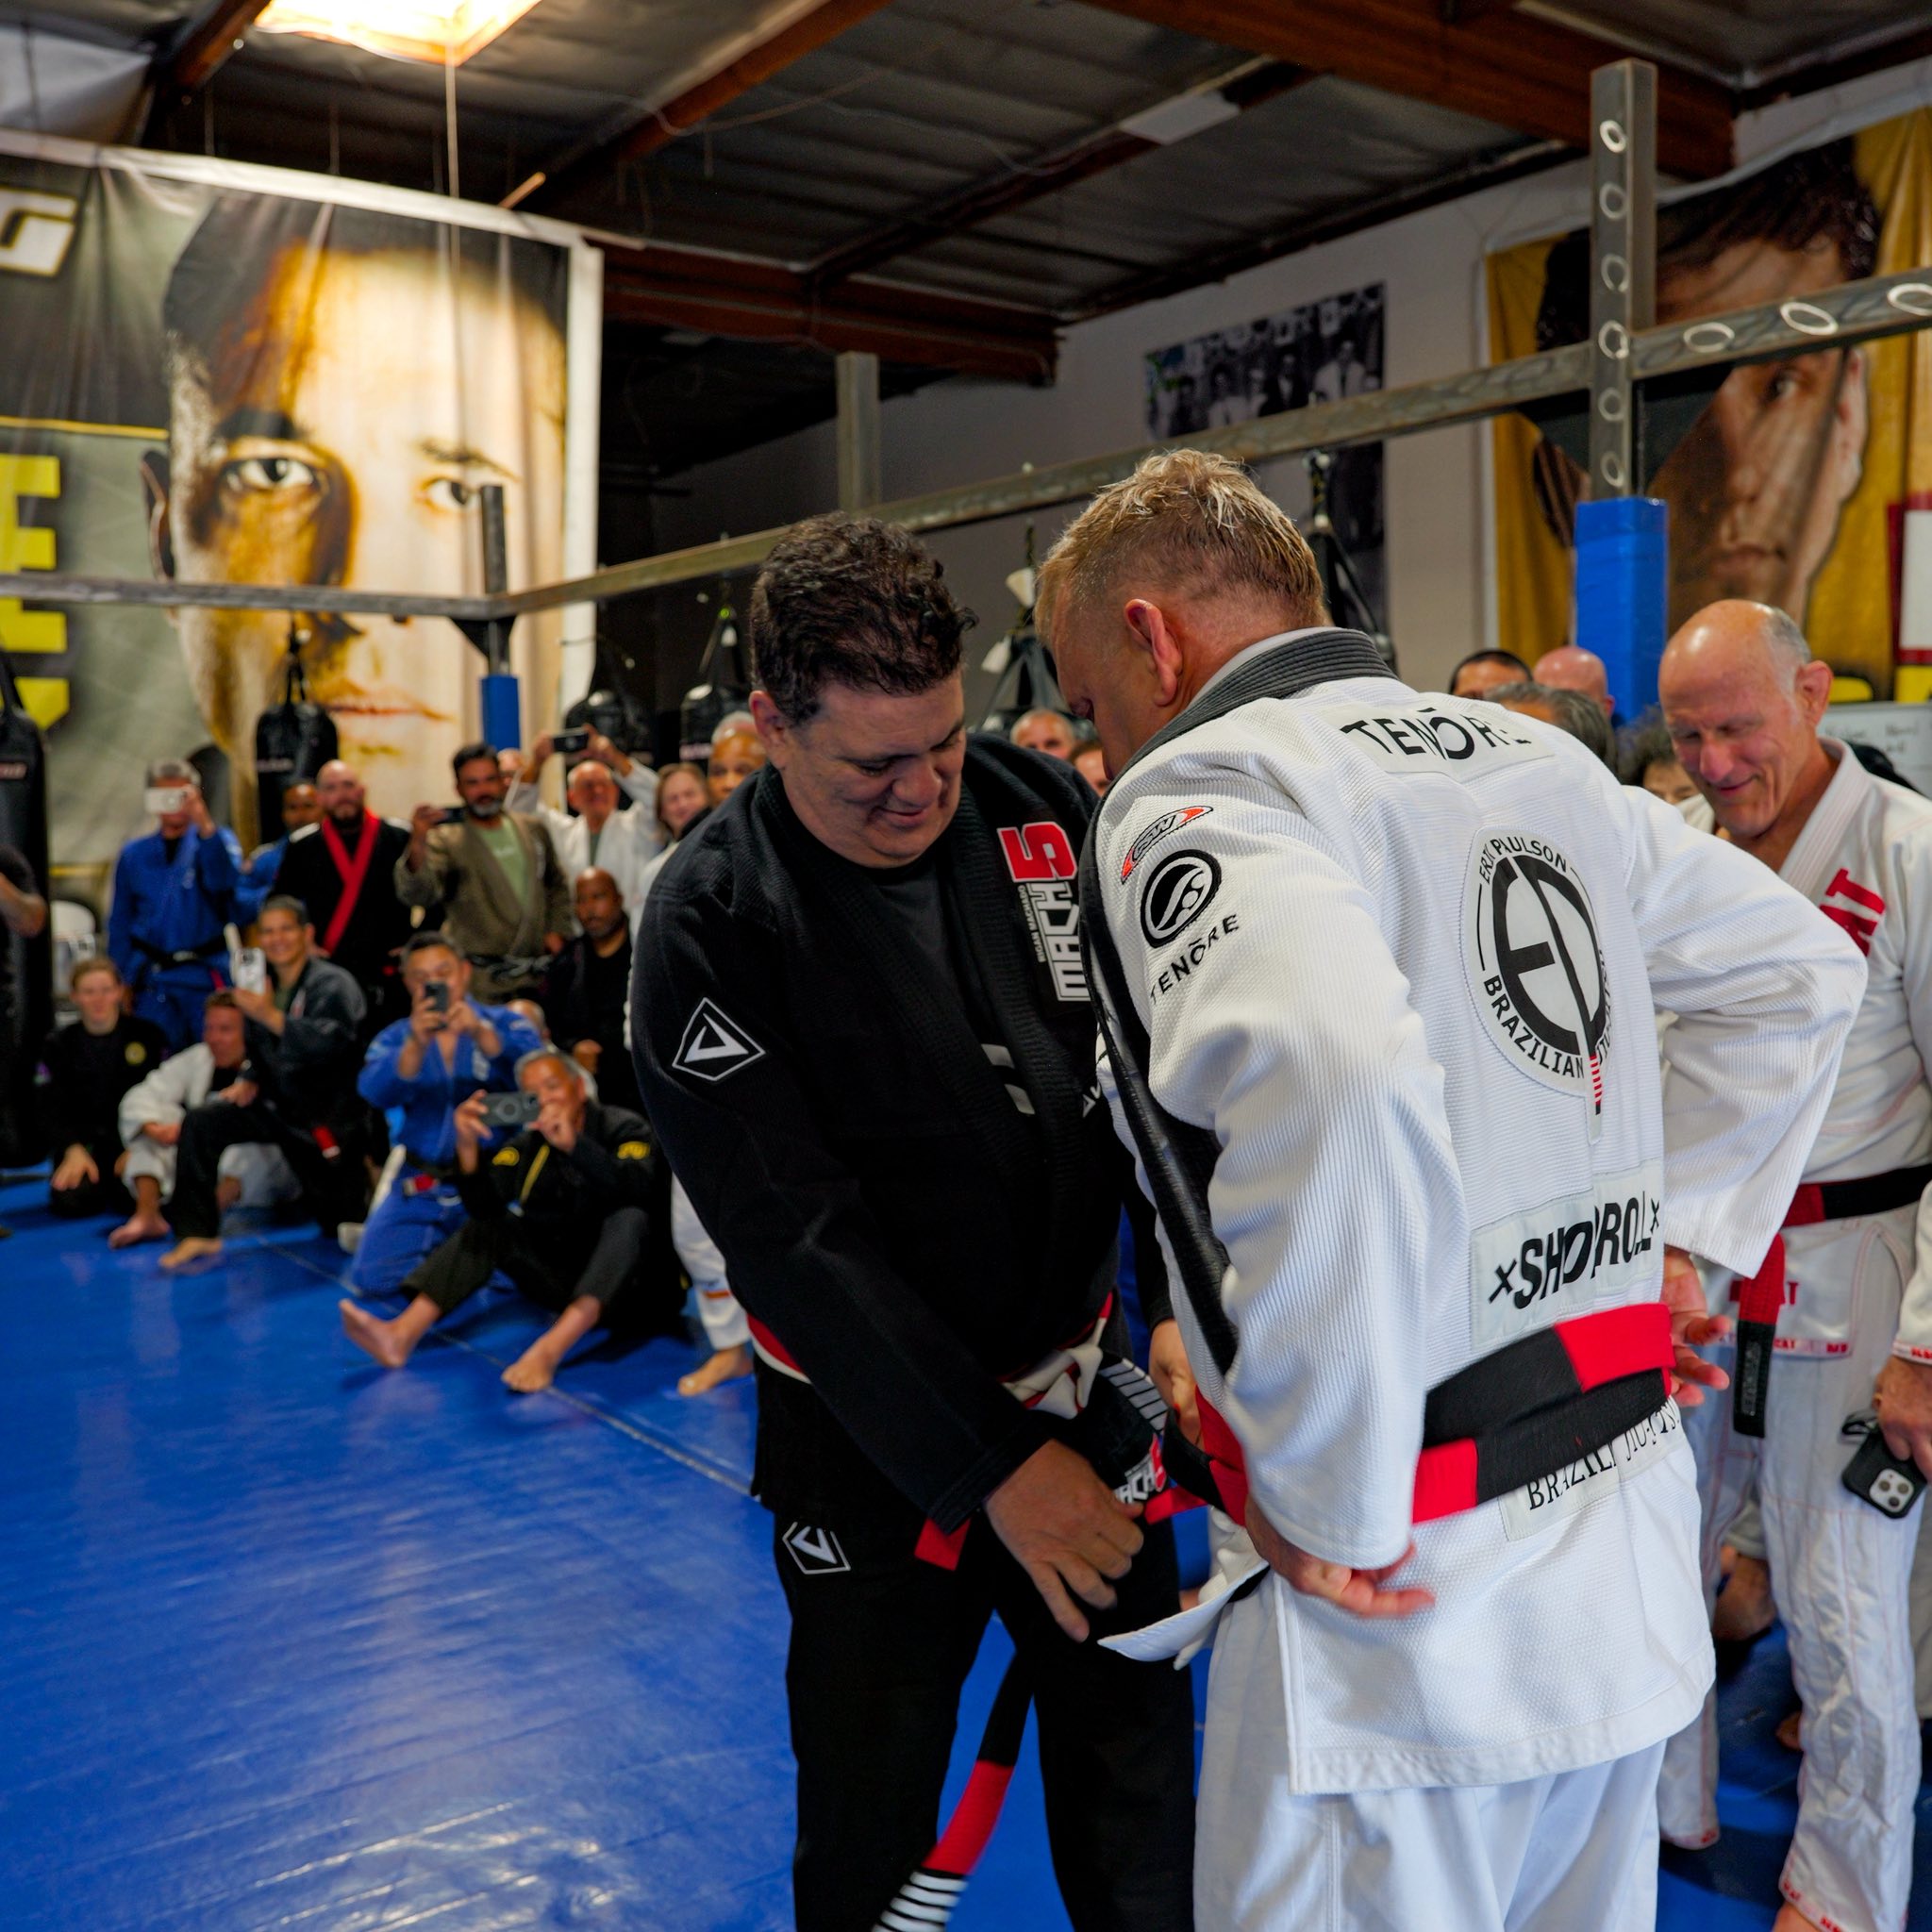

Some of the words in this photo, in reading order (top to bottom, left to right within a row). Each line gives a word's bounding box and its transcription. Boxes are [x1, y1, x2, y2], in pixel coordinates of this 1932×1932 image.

[996, 821, 1078, 883] 5
[1017, 883, 1037, 932] MACHADO
[1483, 974, 1585, 1079] BRAZILIAN
